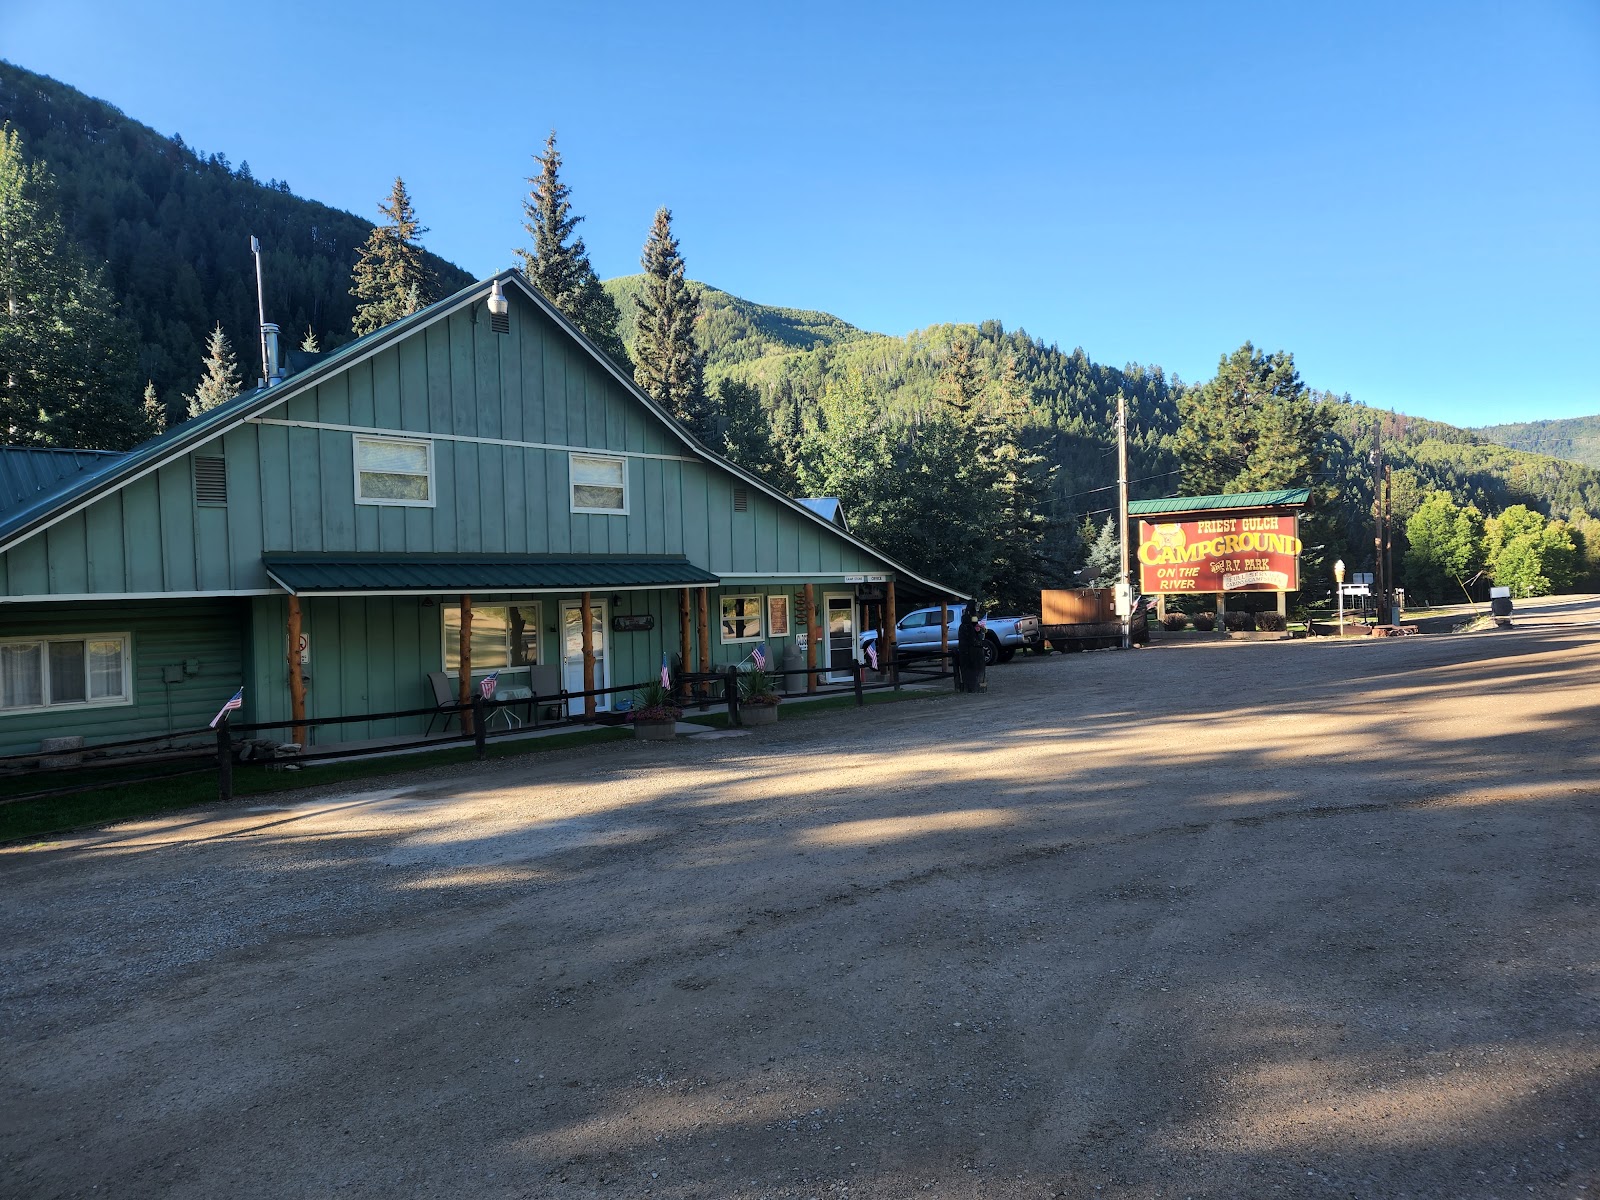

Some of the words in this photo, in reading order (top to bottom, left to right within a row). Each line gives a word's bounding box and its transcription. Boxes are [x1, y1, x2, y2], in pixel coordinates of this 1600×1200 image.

[1198, 519, 1237, 533] PRIEST
[1242, 517, 1279, 532] GULCH
[1138, 532, 1302, 565] CAMPGROUND
[1244, 558, 1270, 571] PARK
[1157, 568, 1175, 578] ON
[1179, 567, 1200, 577] THE
[1160, 579, 1196, 590] RIVER
